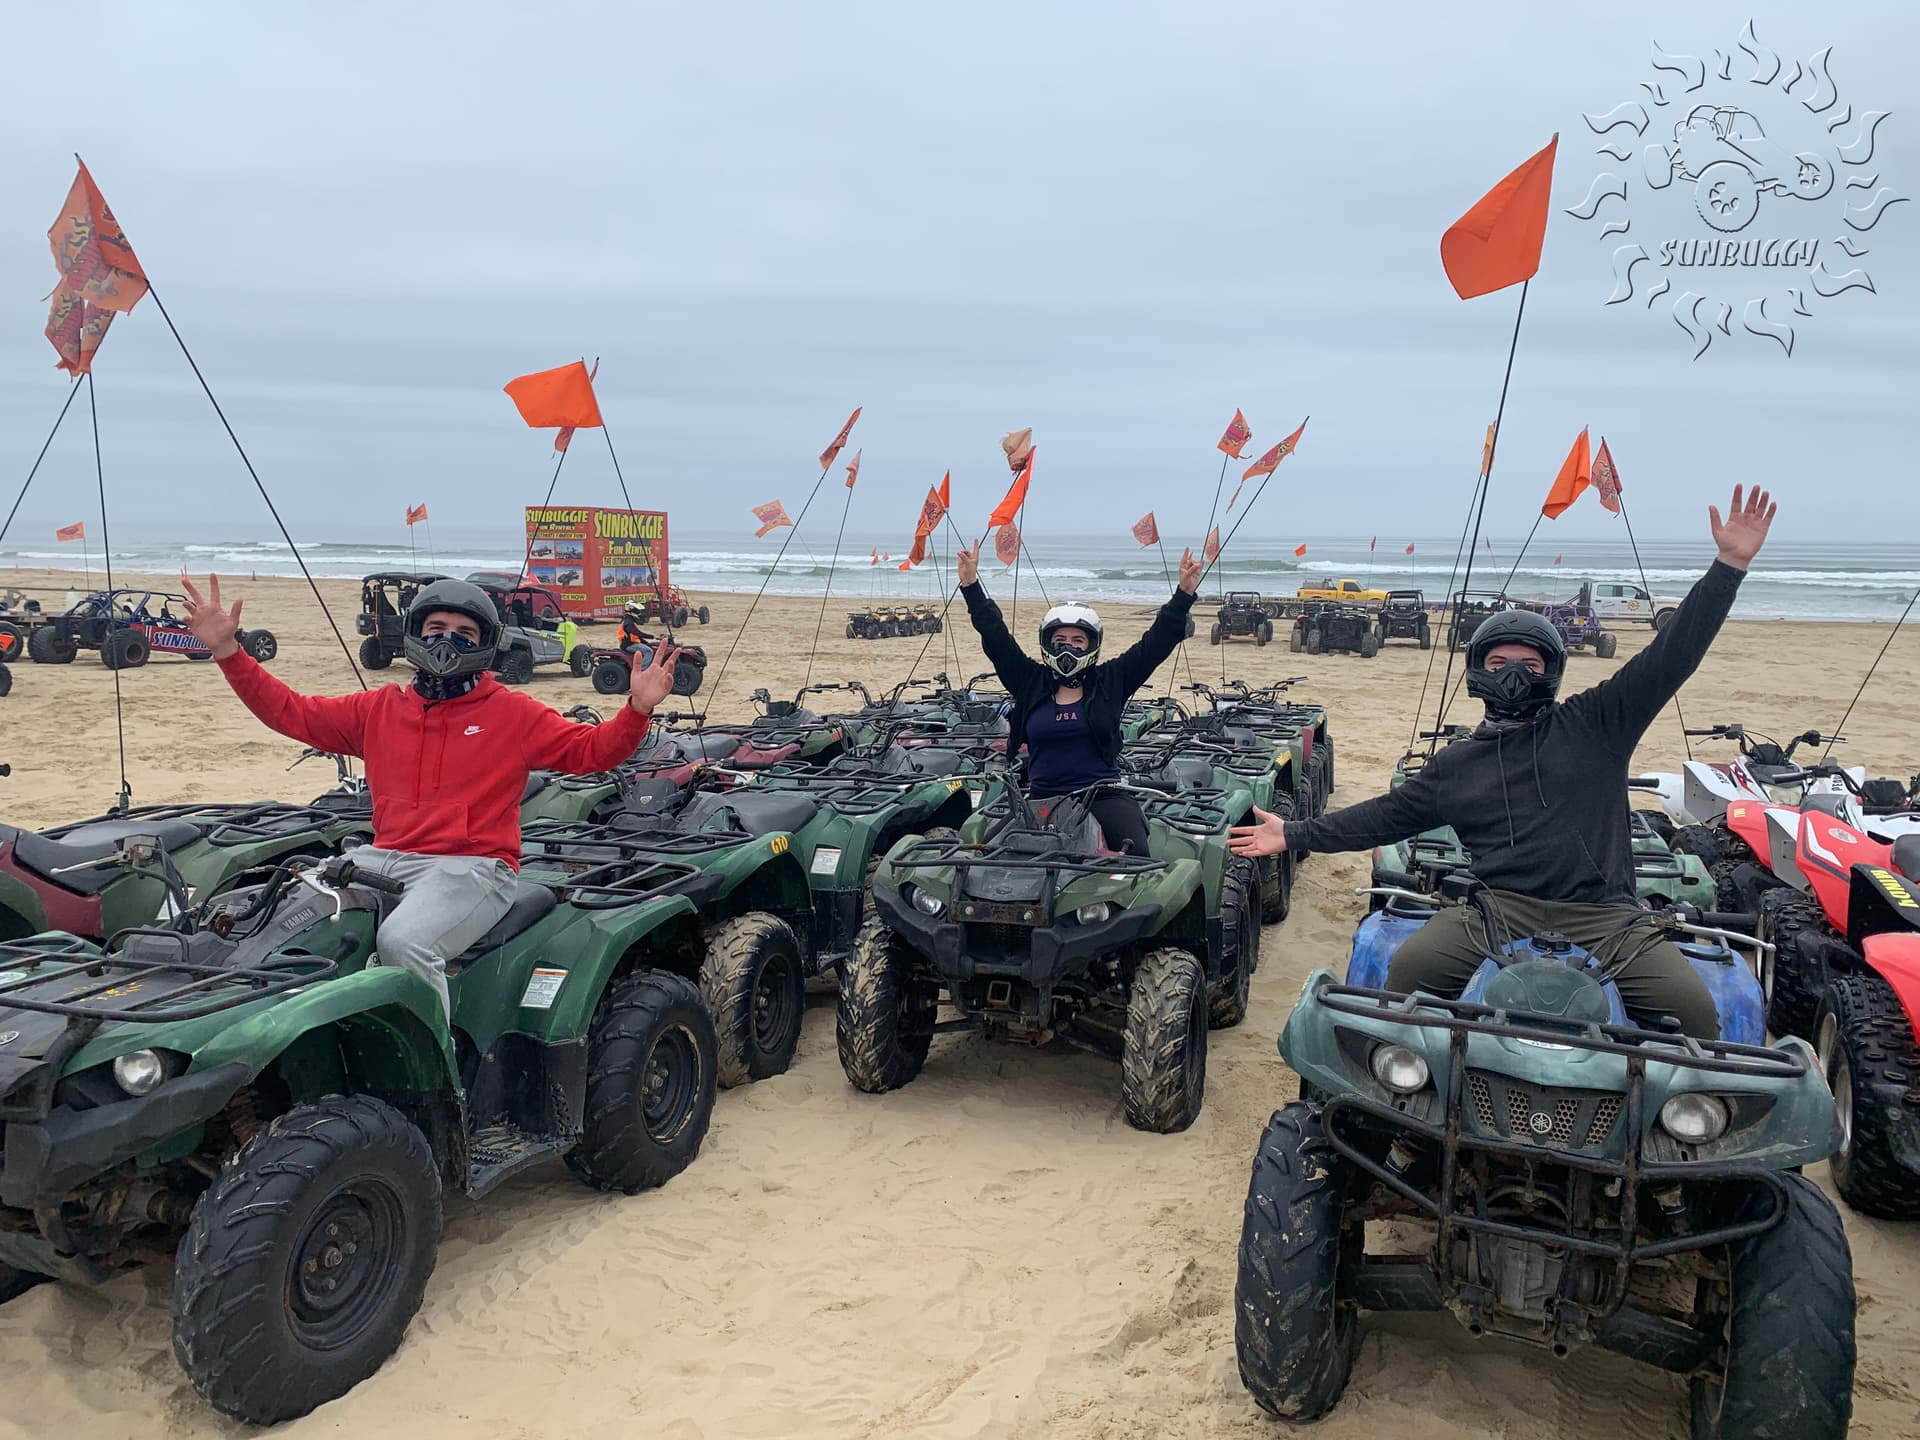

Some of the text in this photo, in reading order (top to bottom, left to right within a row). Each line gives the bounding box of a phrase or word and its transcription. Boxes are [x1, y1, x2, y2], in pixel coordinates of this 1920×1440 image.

[593, 510, 664, 539] SUNBUGGIE
[1056, 711, 1078, 721] USA
[1870, 869, 1920, 908] MINDY
[281, 908, 316, 930] YAMAHA
